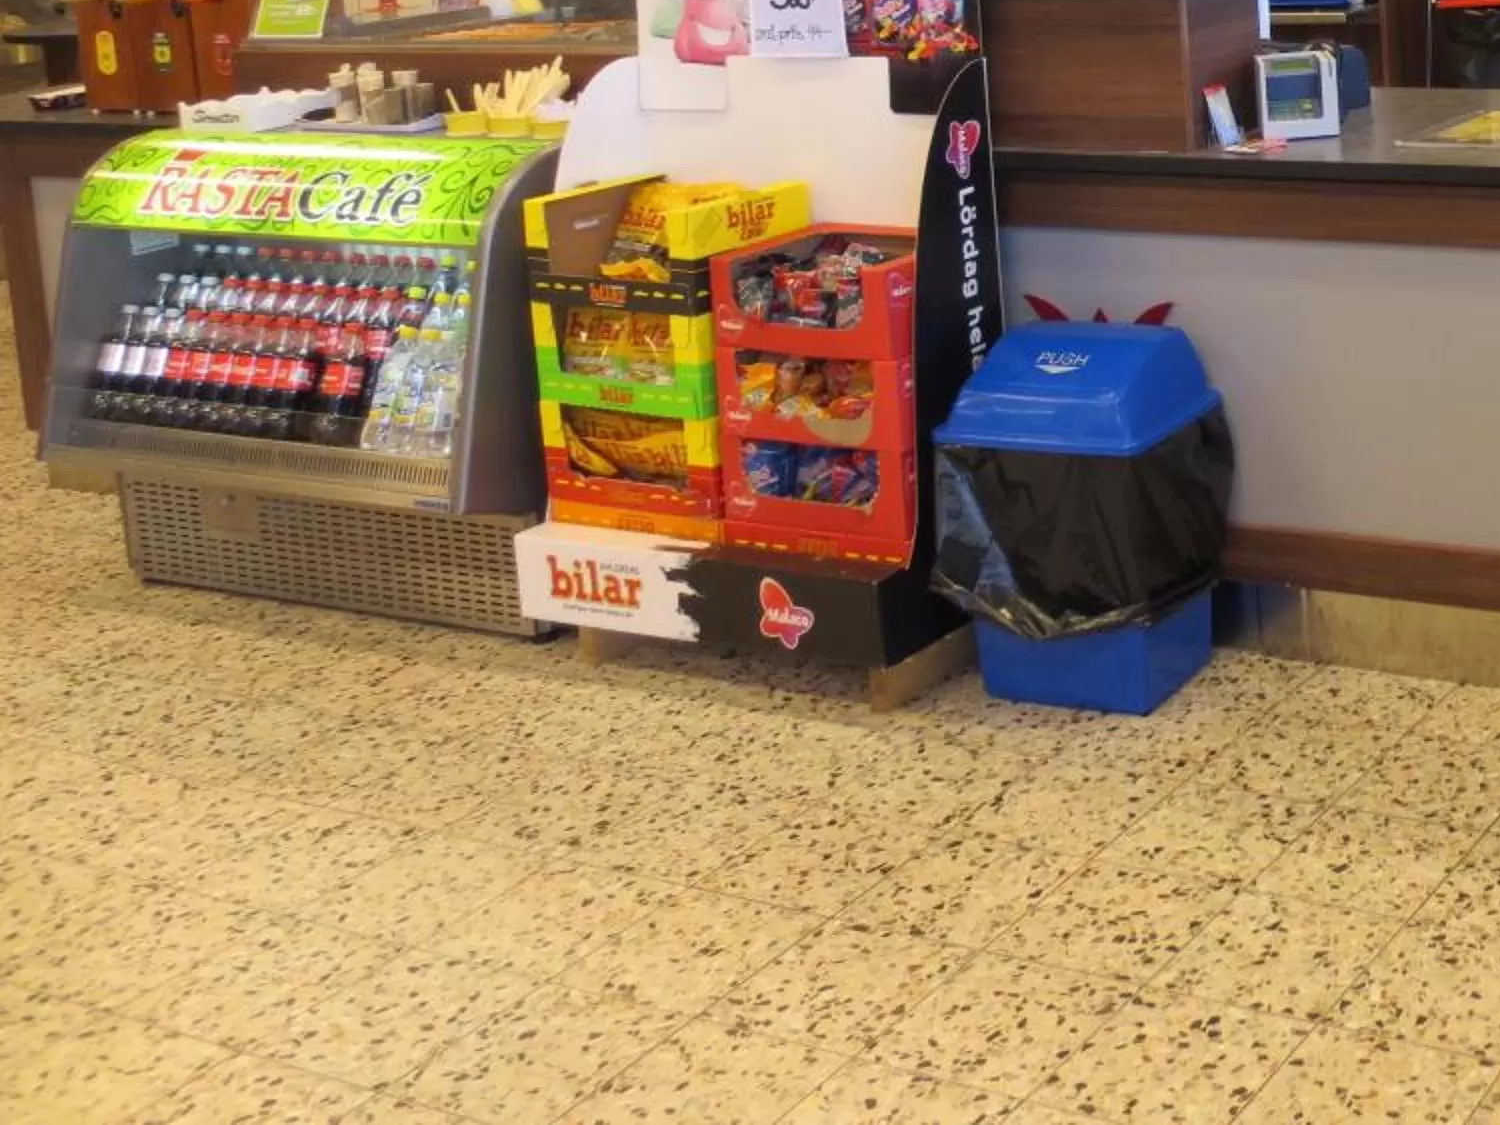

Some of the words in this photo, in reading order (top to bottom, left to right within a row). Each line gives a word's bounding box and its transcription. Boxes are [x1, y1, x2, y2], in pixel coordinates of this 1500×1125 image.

[726, 199, 776, 229] bilar
[958, 185, 979, 299] Lördag
[1035, 350, 1090, 366] PUSH
[546, 554, 643, 610] bilar
[766, 607, 810, 627] Malaco
